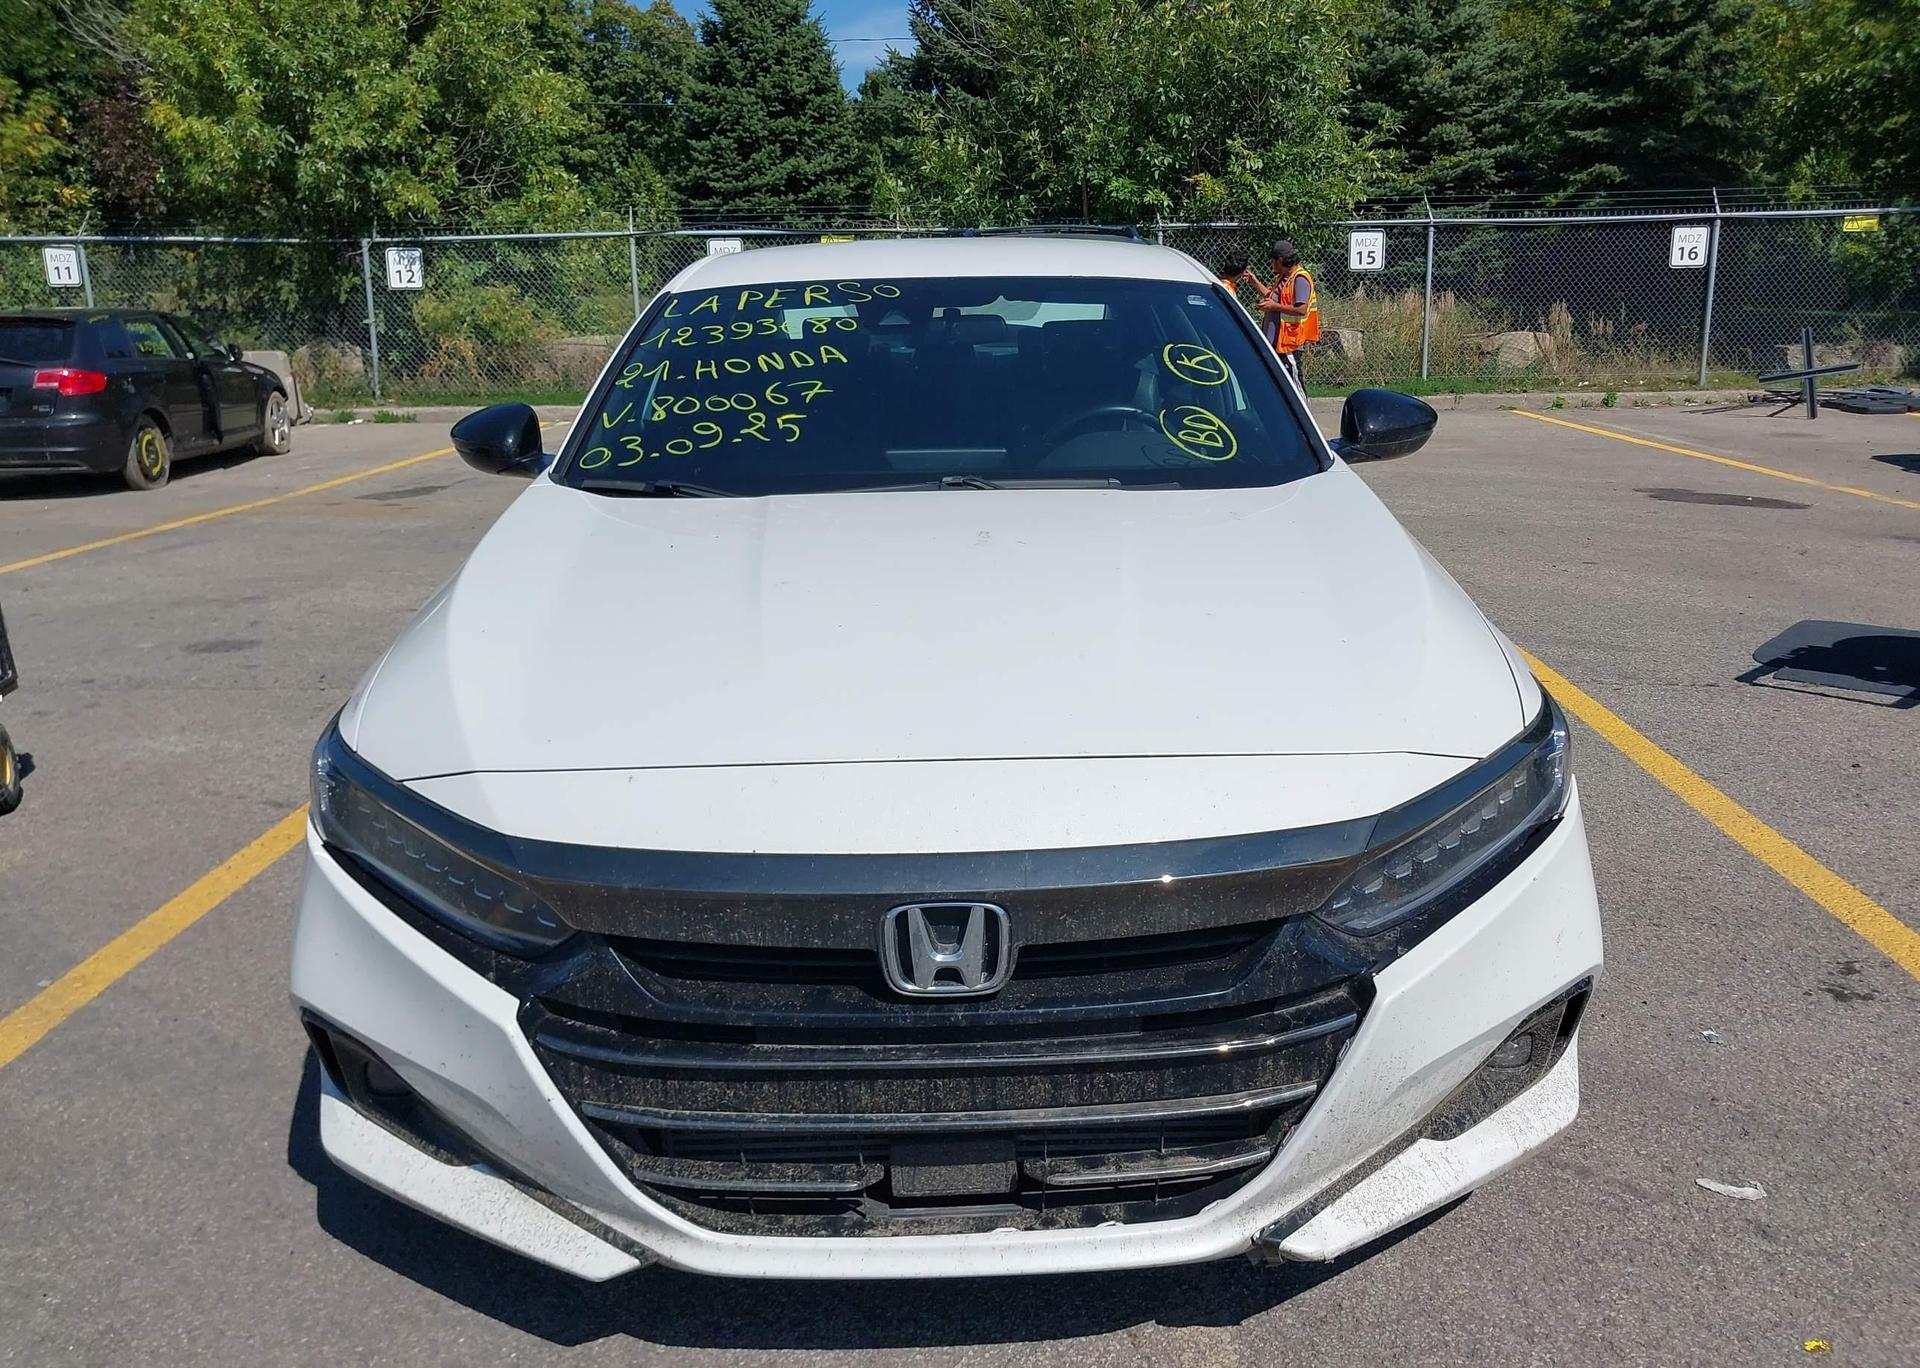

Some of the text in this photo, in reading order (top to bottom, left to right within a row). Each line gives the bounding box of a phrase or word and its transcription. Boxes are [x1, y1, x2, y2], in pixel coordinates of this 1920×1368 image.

[1355, 237, 1379, 248] MDZ
[1679, 233, 1703, 244] MDZ
[50, 253, 72, 263] MDZ
[1356, 250, 1376, 265] 15
[1678, 246, 1699, 261] 16
[54, 266, 72, 280] 11
[395, 269, 416, 284] 12
